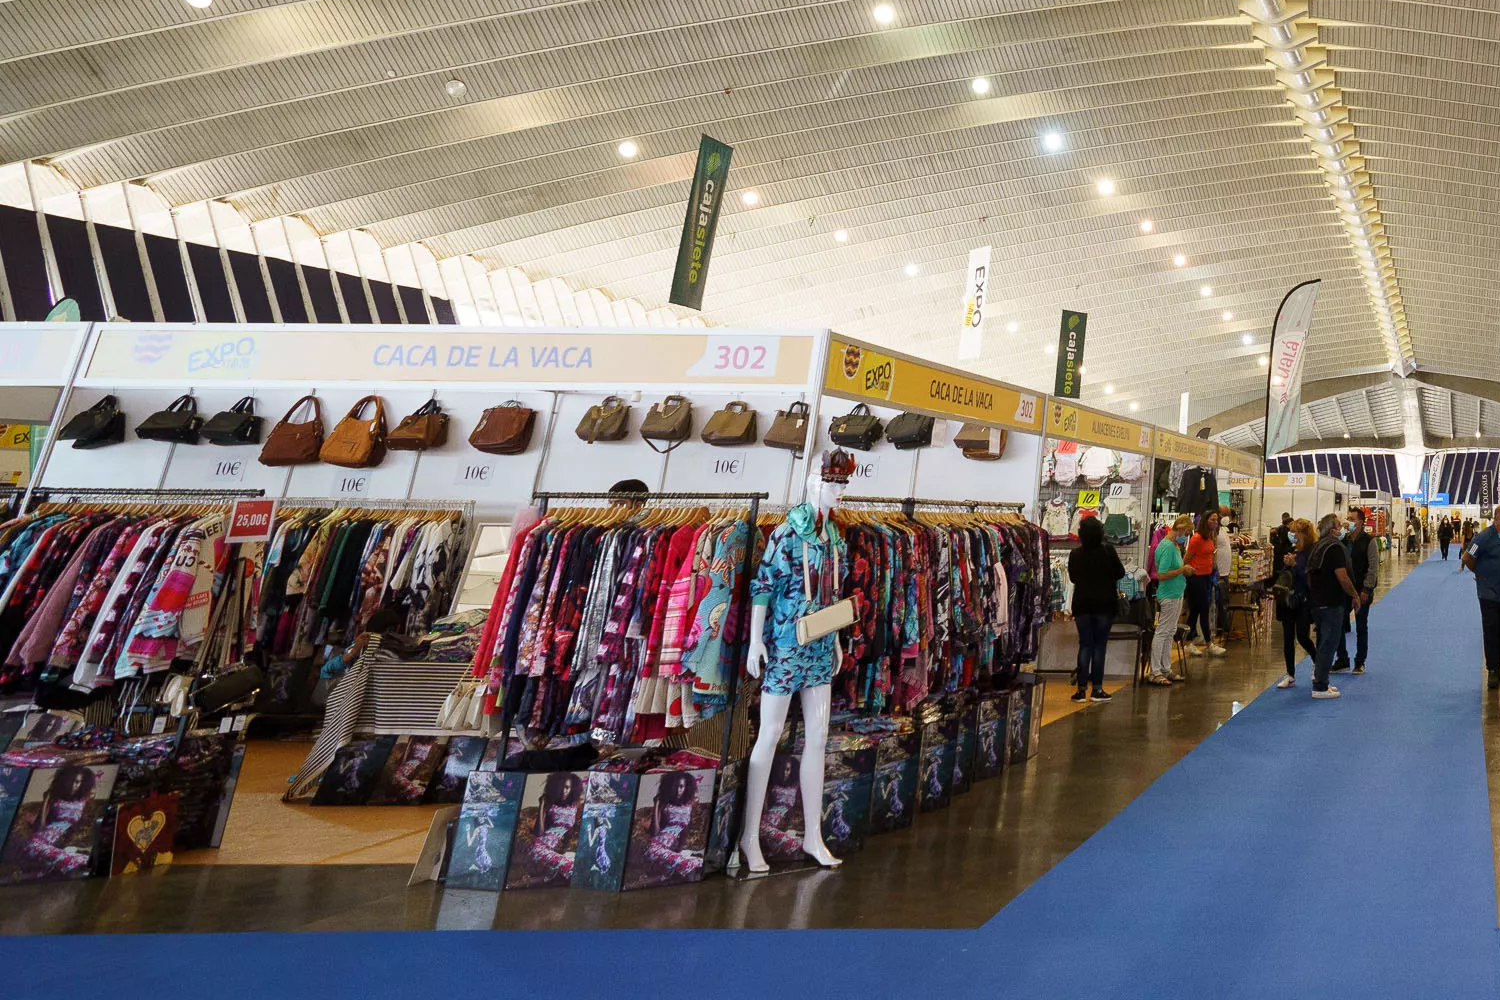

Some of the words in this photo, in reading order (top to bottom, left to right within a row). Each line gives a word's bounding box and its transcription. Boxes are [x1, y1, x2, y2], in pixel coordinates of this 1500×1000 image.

[688, 179, 715, 284] cajasiete
[971, 266, 985, 328] EXPO
[187, 336, 256, 373] EXPO
[372, 344, 438, 367] CACA
[446, 345, 482, 368] DE
[487, 346, 519, 368] LA
[530, 346, 593, 369] VACA
[714, 345, 767, 370] 302
[1063, 331, 1077, 395] cajasiete
[866, 361, 892, 390] EXPO
[930, 379, 950, 403] CACA
[952, 385, 964, 405] DE
[964, 388, 974, 406] LA
[975, 392, 992, 411] VACA
[1020, 399, 1034, 419] 302
[14, 431, 30, 445] EX
[215, 460, 242, 477] 10€
[463, 464, 490, 482] 10€
[713, 458, 740, 474] 10€
[850, 463, 874, 478] 0€
[340, 476, 366, 493] 10€
[1111, 486, 1123, 496] 10
[1083, 494, 1095, 504] 10
[236, 514, 268, 528] 25,00€
